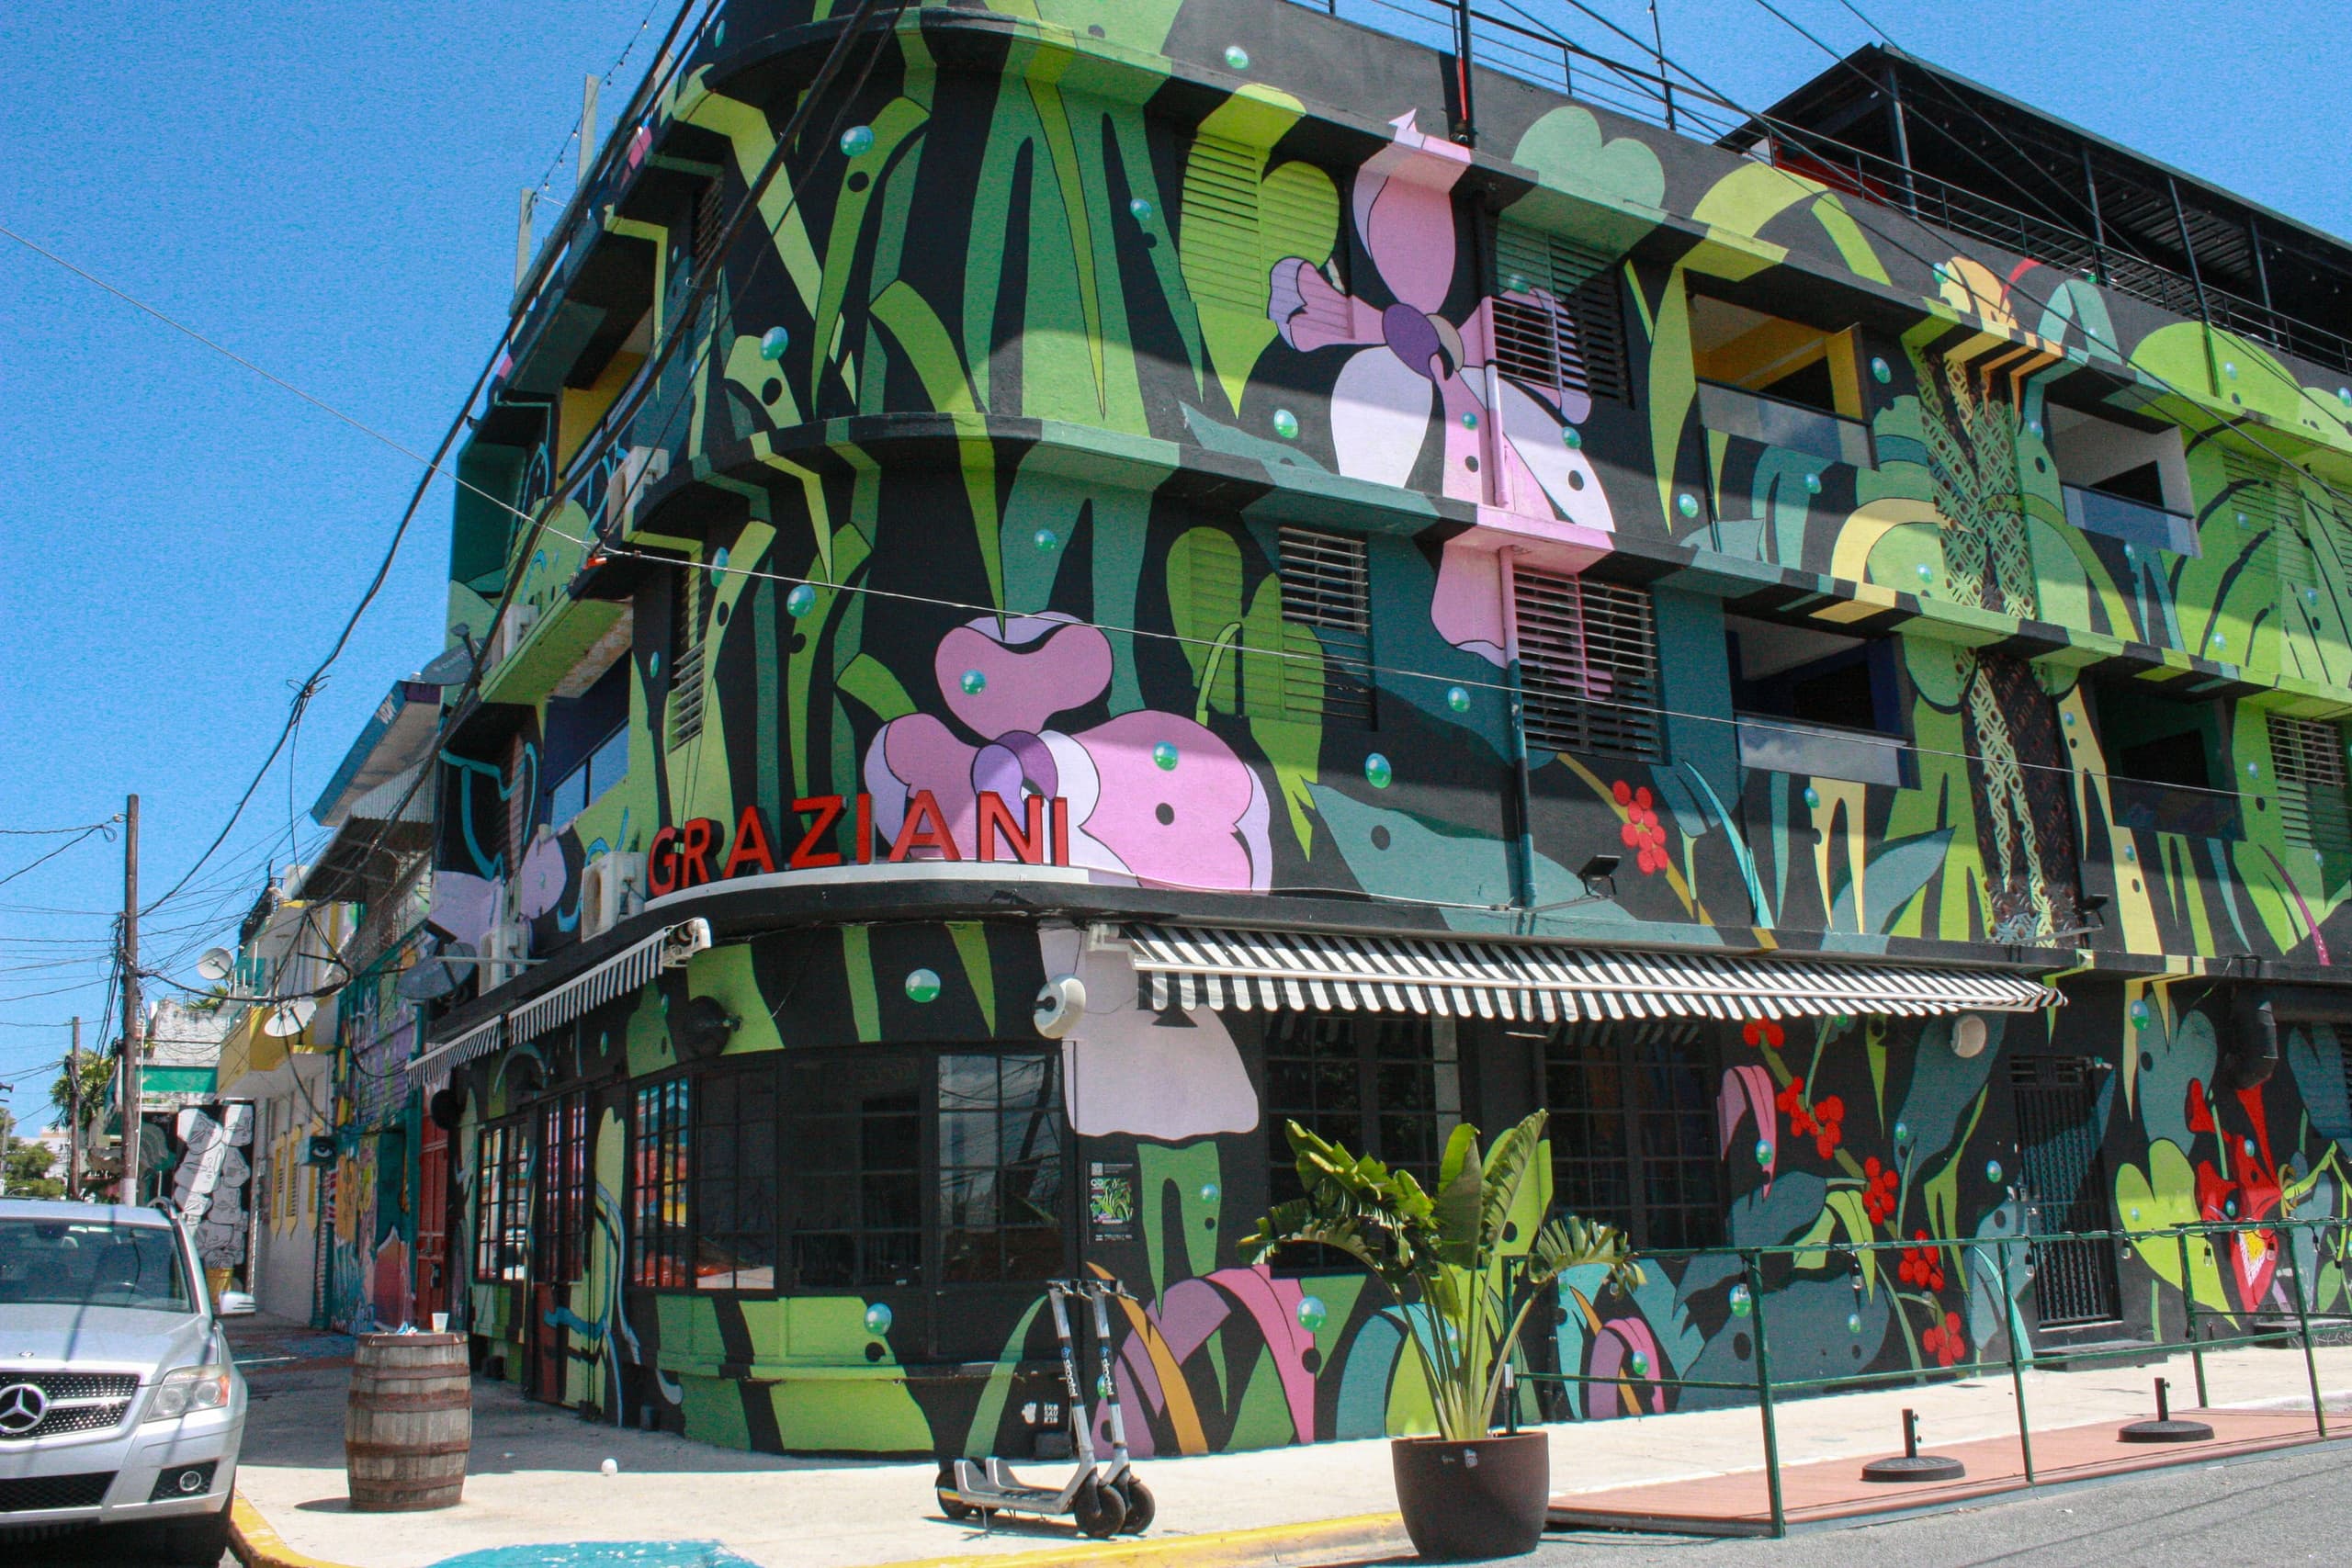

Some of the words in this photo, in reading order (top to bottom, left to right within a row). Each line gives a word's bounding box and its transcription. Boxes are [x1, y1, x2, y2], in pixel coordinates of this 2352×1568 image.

[647, 789, 1069, 897] GRAZIANI
[1064, 1359, 1078, 1396] skootel
[1102, 1359, 1114, 1394] skootel
